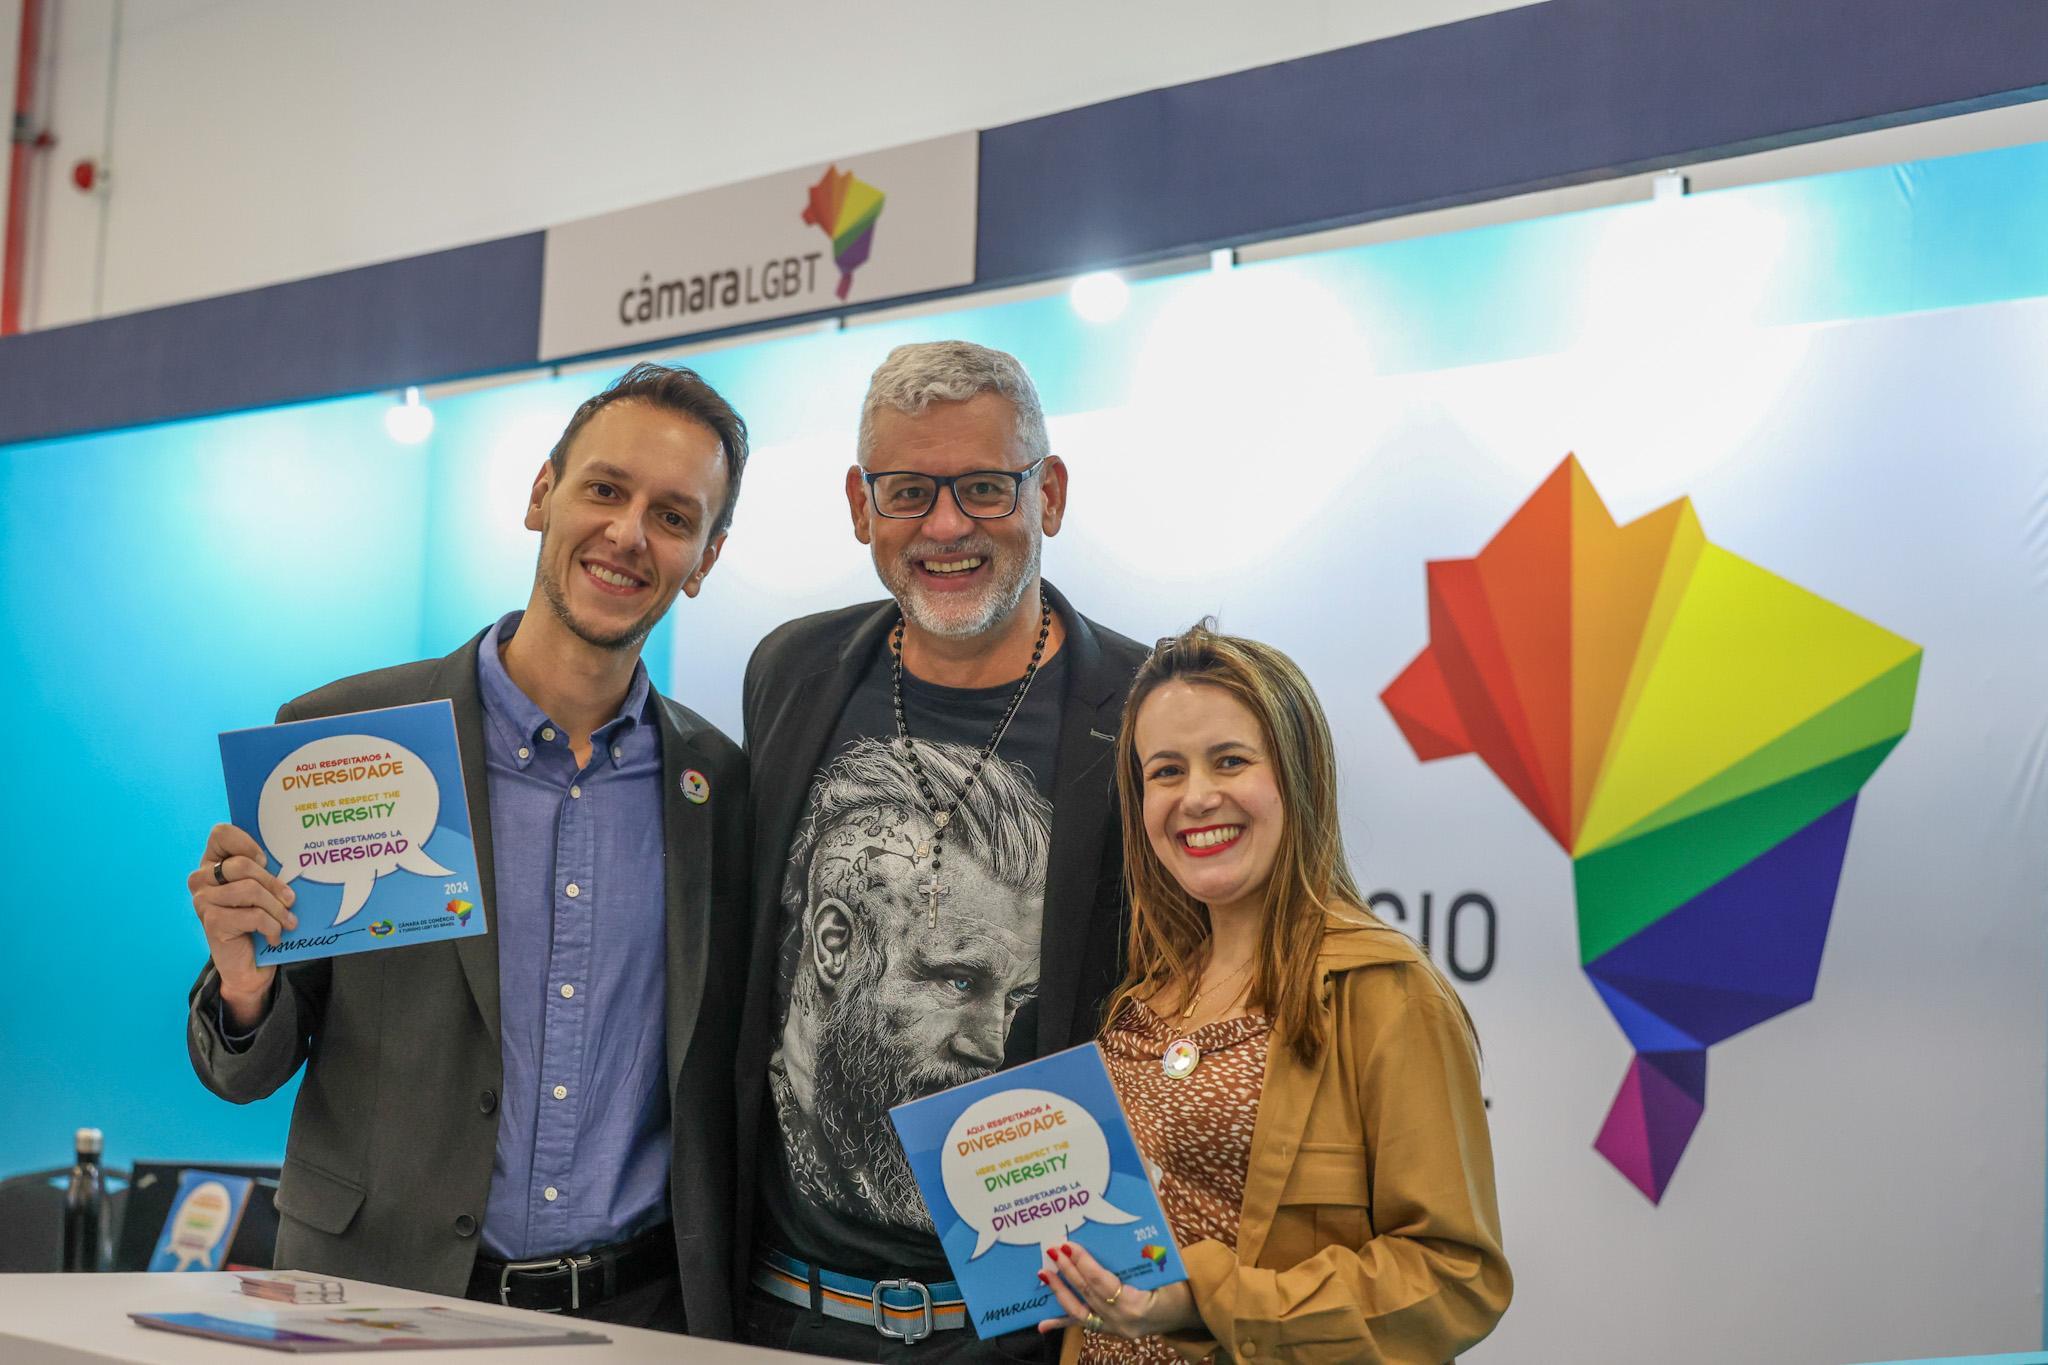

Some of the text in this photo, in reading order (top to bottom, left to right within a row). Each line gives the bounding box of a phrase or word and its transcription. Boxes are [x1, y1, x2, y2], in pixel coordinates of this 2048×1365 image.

[282, 761, 404, 791] DIVERSIDADE
[296, 763, 317, 772] AQUI
[319, 754, 382, 768] RESPEITAMOS
[295, 790, 400, 812] HERE WE RESPECT THE
[302, 801, 396, 829] DIVERSITY
[299, 839, 408, 867] DIVERSIDAD
[304, 829, 402, 850] AQUI RESPETAMOS LA
[444, 881, 469, 895] 2024
[957, 1110, 1067, 1156] DIVERSIDADE
[967, 1125, 985, 1136] AQUI
[987, 1106, 1043, 1129] RESPEITAMOS
[975, 1140, 1070, 1176] HERE WE RESPECT THE
[984, 1152, 1067, 1192] DIVERSITY
[992, 1190, 1089, 1232] DIVERSIDAD
[993, 1181, 1081, 1214] AQUI RESPETAMOS LA
[1134, 1225, 1159, 1242] 2024
